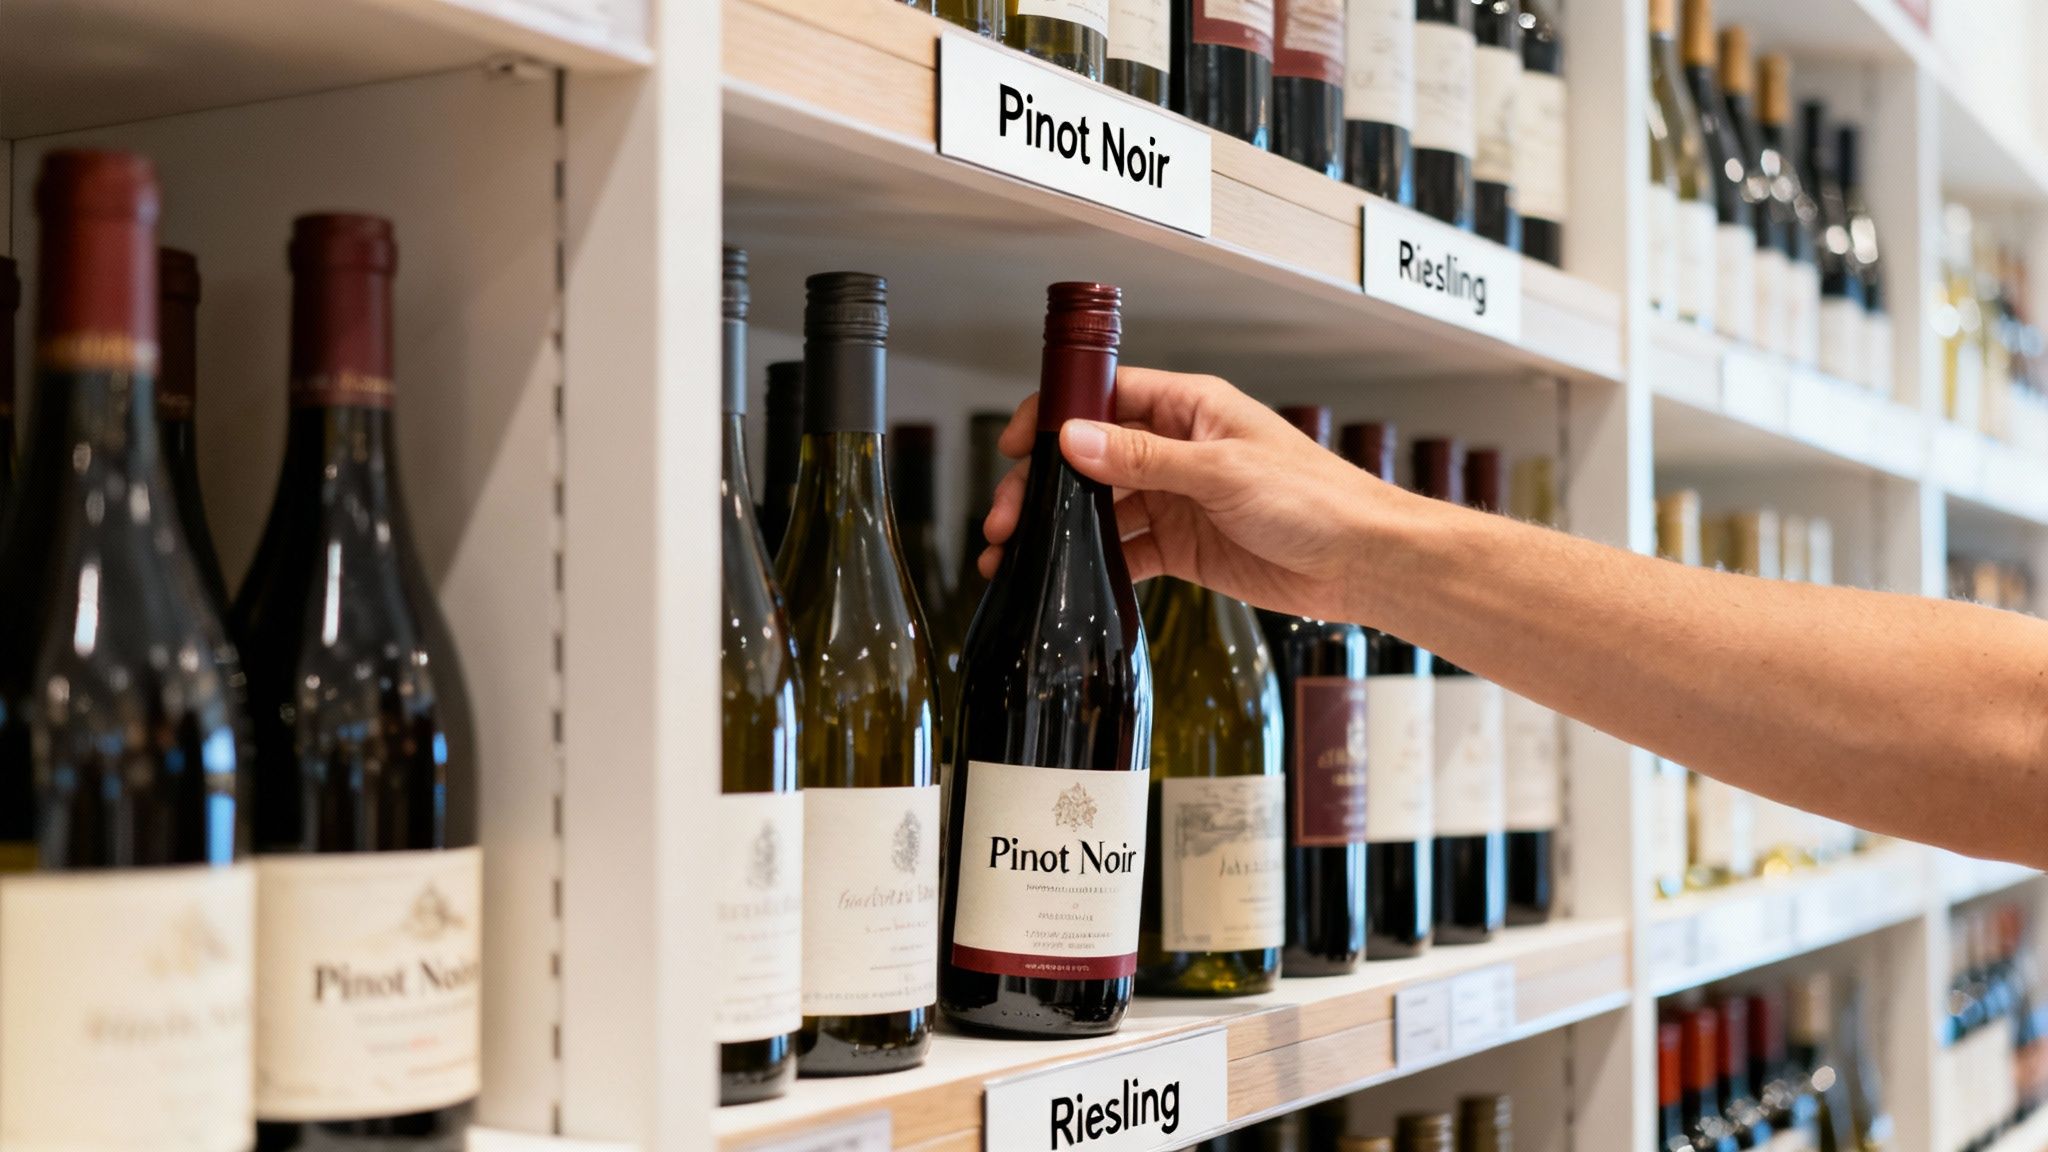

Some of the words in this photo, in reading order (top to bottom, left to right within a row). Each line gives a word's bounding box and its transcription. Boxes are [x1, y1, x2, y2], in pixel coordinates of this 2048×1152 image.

[999, 83, 1090, 165] Pinot
[1102, 121, 1170, 188] Noir
[1399, 239, 1487, 316] Riesling
[988, 836, 1070, 874] Pinot
[1079, 840, 1137, 875] Noir
[312, 962, 405, 1004] Pinot
[1051, 1078, 1180, 1151] Riesling
